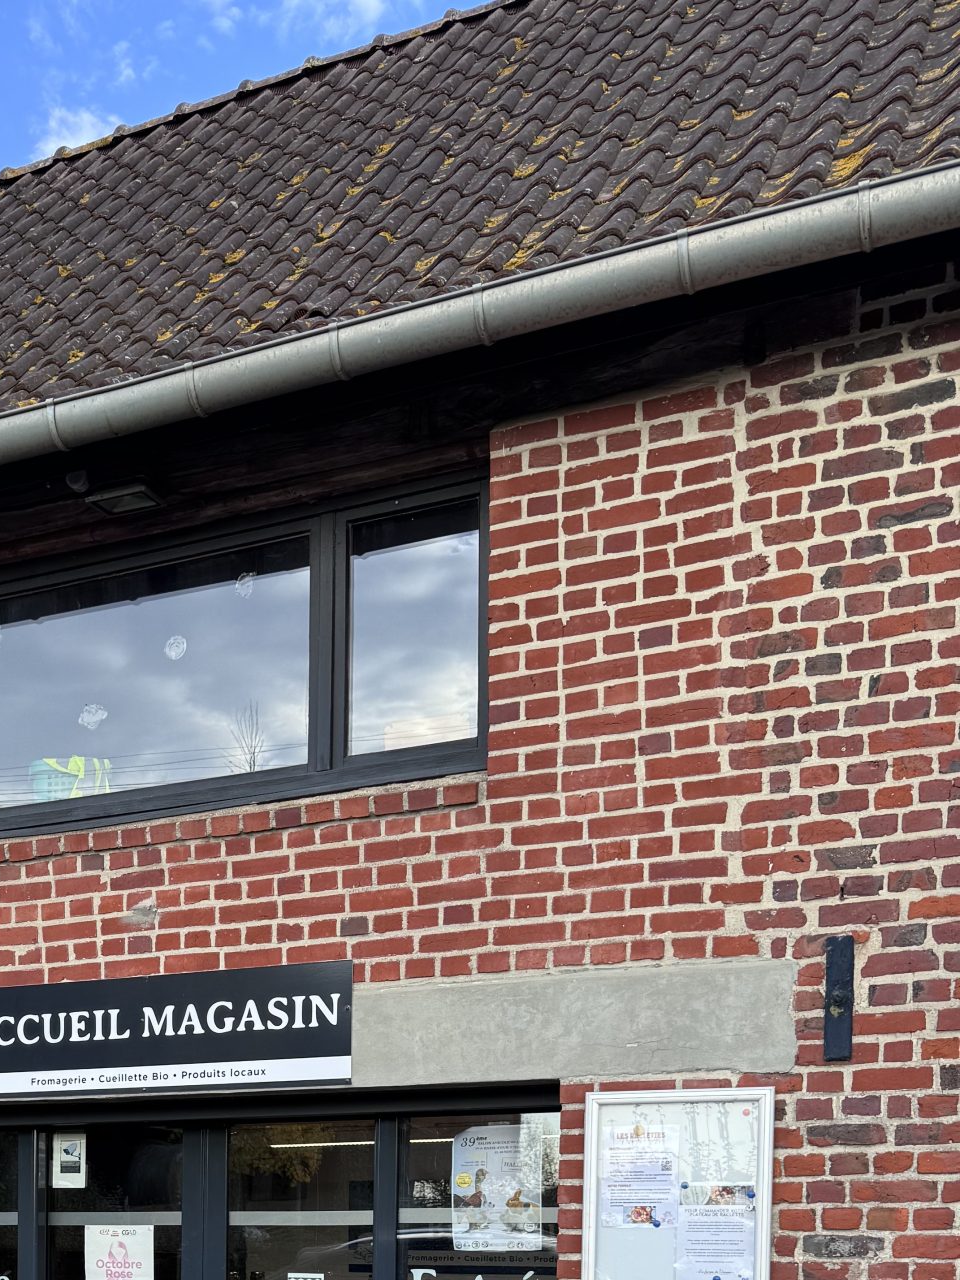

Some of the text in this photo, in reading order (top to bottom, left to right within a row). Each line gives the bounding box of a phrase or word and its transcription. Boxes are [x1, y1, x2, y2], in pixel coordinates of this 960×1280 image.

[140, 992, 342, 1038] MAGASIN
[30, 1067, 267, 1088] Fromagerie Cueillette Bio Produits locaux
[95, 1258, 143, 1270] Octobre
[464, 1254, 507, 1263] Cueillette
[509, 1254, 524, 1263] Bio
[105, 1268, 134, 1279] Rose
